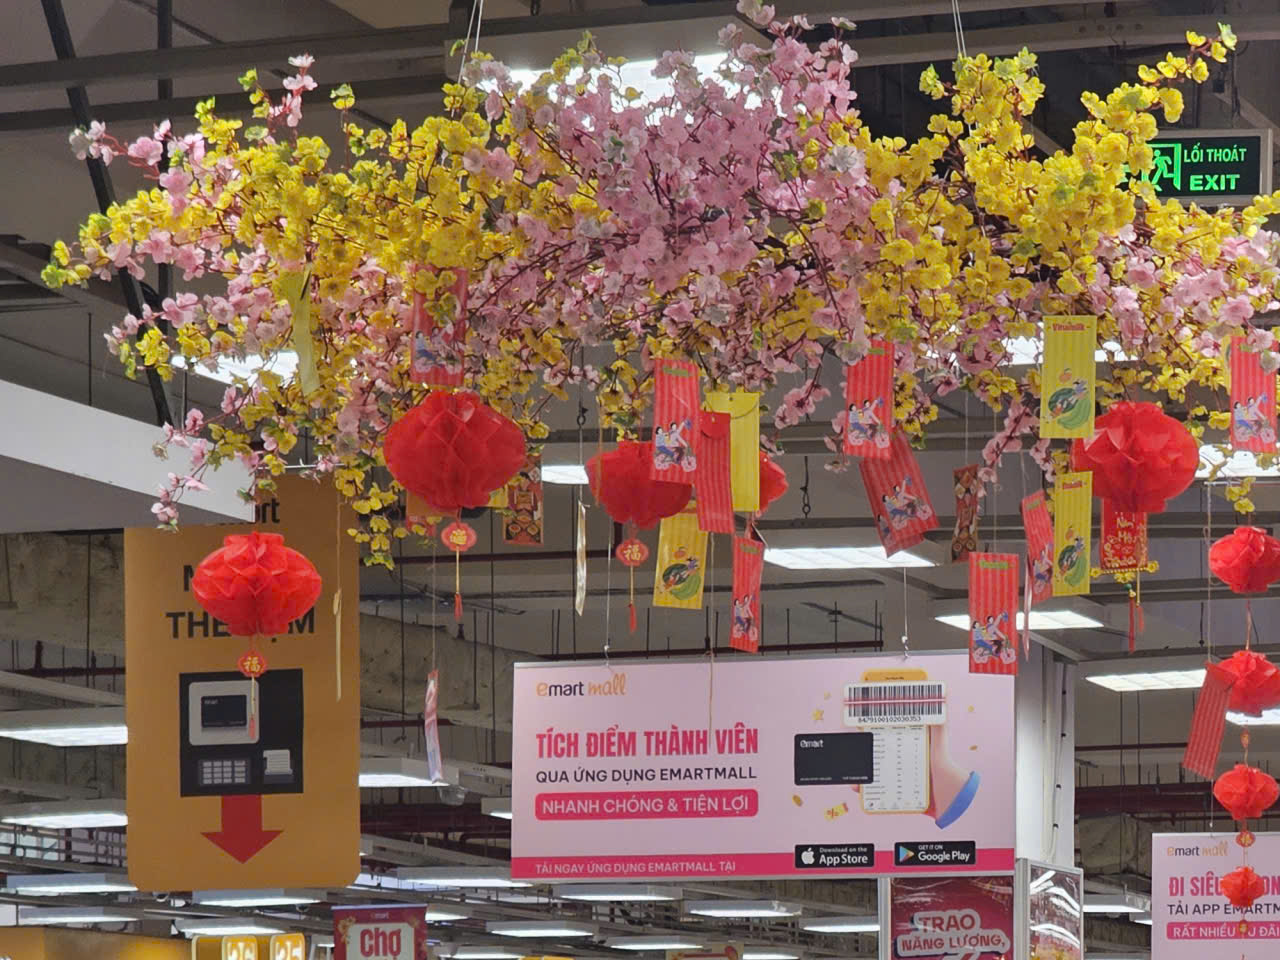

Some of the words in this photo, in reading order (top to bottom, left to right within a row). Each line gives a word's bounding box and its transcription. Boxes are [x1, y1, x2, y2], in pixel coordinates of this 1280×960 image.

[1184, 142, 1204, 162] LỐI
[1206, 144, 1247, 162] THOÁT
[1190, 174, 1240, 191] EXIT
[243, 656, 261, 673] 福
[536, 680, 585, 697] emart
[587, 672, 628, 697] mall
[536, 727, 579, 759] TÍCH
[586, 723, 636, 758] ĐIỂM
[644, 724, 709, 757] THÀNH
[715, 721, 759, 754] VIÊN
[536, 770, 570, 784] QUA
[574, 766, 608, 783] ỨNG
[611, 768, 656, 785] DỤNG
[660, 766, 757, 781] EMARTMALL
[542, 798, 600, 815] NHANH
[603, 795, 664, 813] CHÓNG
[667, 798, 678, 812] &
[683, 795, 719, 814] TIỆN
[722, 795, 749, 814] LỢI
[819, 853, 840, 867] App
[841, 852, 869, 865] Store
[918, 851, 950, 863] Google
[951, 850, 971, 862] Play
[1166, 844, 1200, 857] emart
[536, 861, 553, 874] TẢI
[554, 864, 586, 875] NGAY
[587, 861, 613, 873] ỨNG
[613, 862, 647, 876] DỤNG
[648, 861, 716, 873] EMARTMALL
[719, 860, 736, 872] TẠI
[1169, 876, 1188, 897] ĐI
[1168, 902, 1189, 915] TẢI
[1192, 903, 1220, 915] APP
[920, 913, 975, 933] TRAO
[1173, 923, 1197, 938] RẤT
[1199, 922, 1235, 938] NHIỀU
[1259, 923, 1280, 938] ĐÃI
[359, 927, 402, 957] Chợ
[902, 934, 945, 952] NĂNG
[949, 932, 1006, 949] LƯỢNG,
